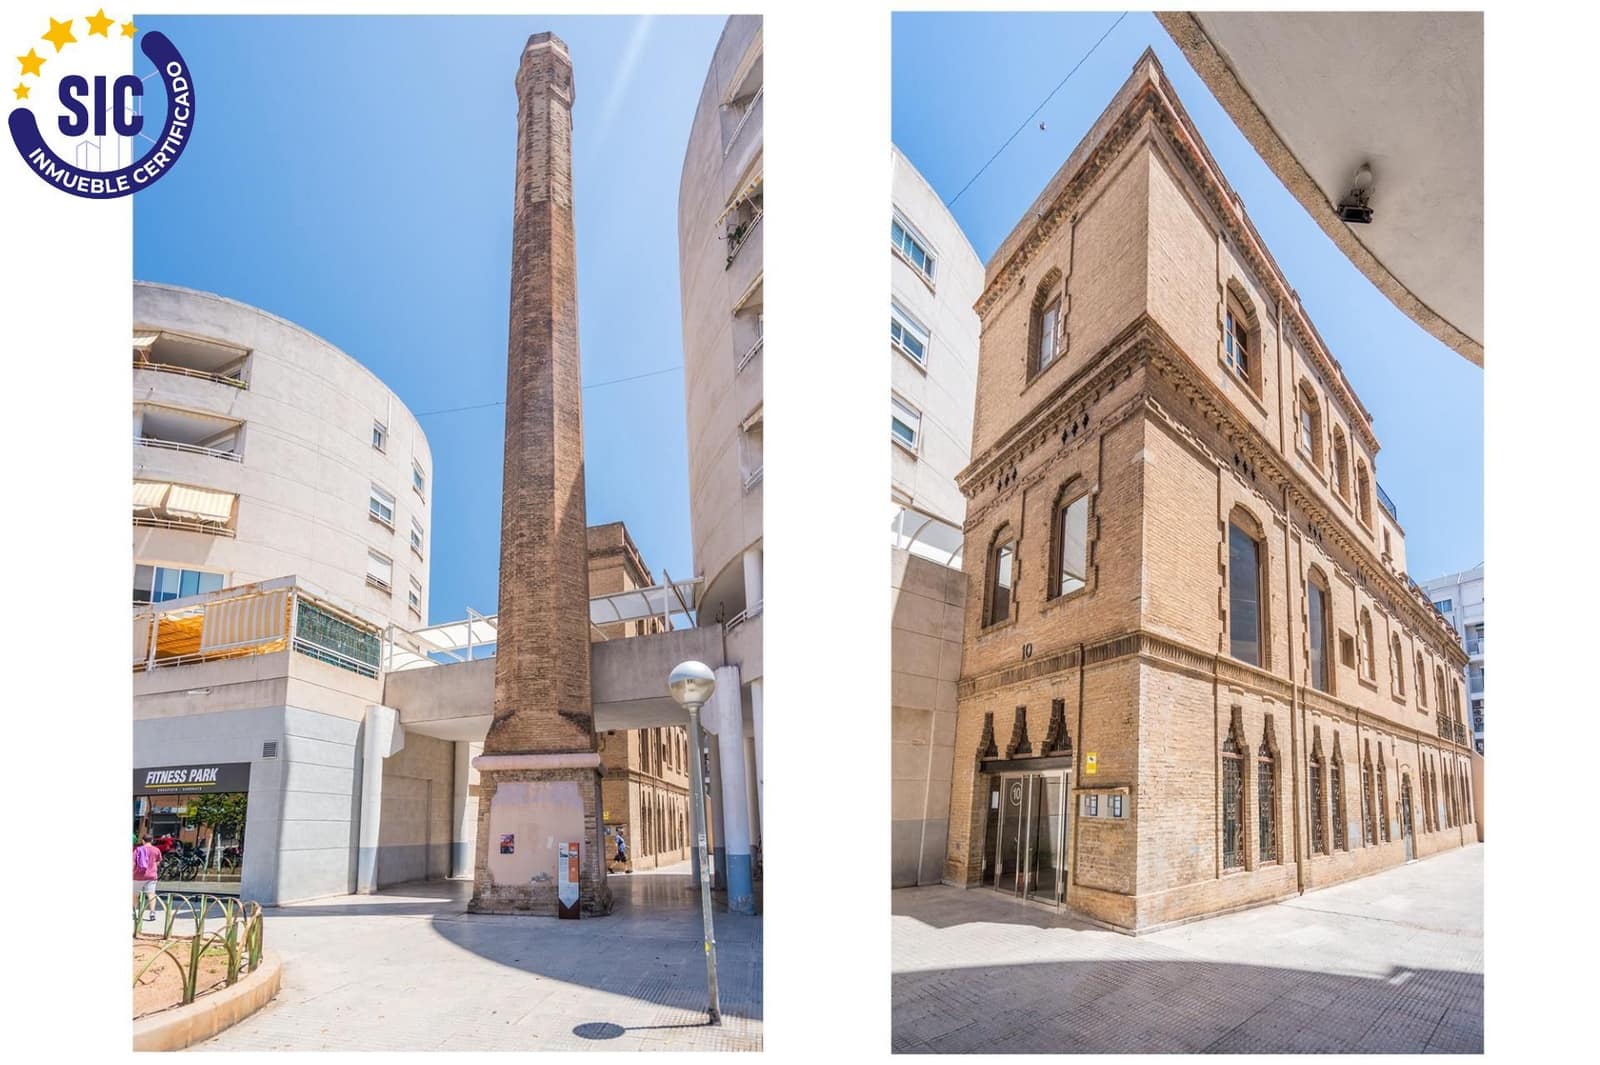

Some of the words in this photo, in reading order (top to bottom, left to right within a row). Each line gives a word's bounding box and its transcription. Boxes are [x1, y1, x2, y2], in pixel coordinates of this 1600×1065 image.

[1022, 643, 1033, 660] 10
[145, 769, 187, 784] FITNESS
[189, 768, 219, 782] PARK
